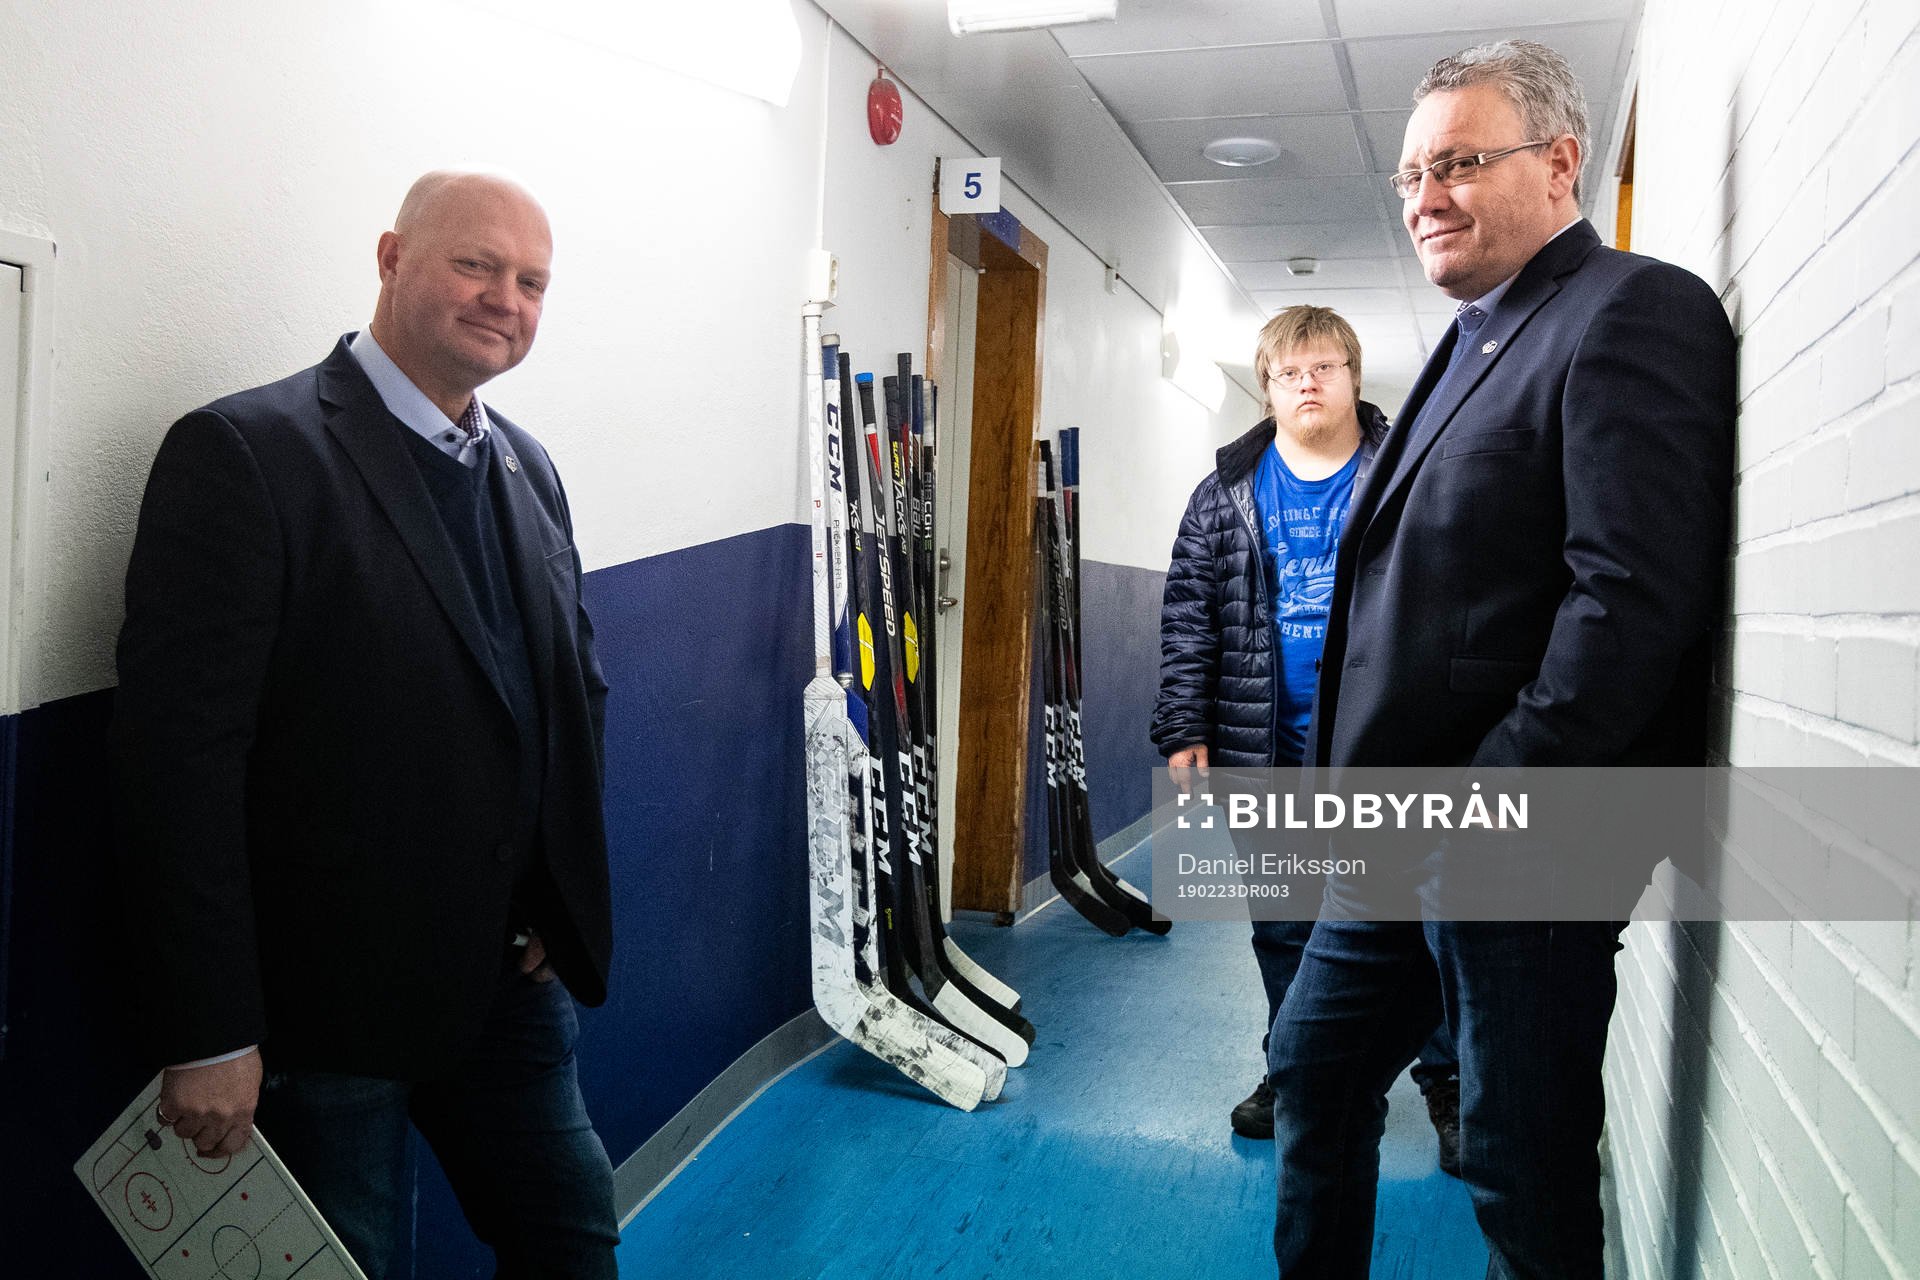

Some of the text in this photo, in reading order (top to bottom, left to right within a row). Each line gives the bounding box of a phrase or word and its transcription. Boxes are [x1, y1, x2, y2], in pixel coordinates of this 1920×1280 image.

[964, 173, 982, 199] 5
[827, 402, 842, 492] CCM
[892, 441, 901, 478] SUPER
[893, 478, 908, 536] TACKS
[874, 504, 896, 637] JETSPEED
[1277, 620, 1323, 639] HENT
[1045, 704, 1057, 789] CCM
[1069, 710, 1088, 792] CCM
[870, 755, 893, 876] CCM
[898, 751, 922, 866] CCM
[913, 744, 933, 854] CCM
